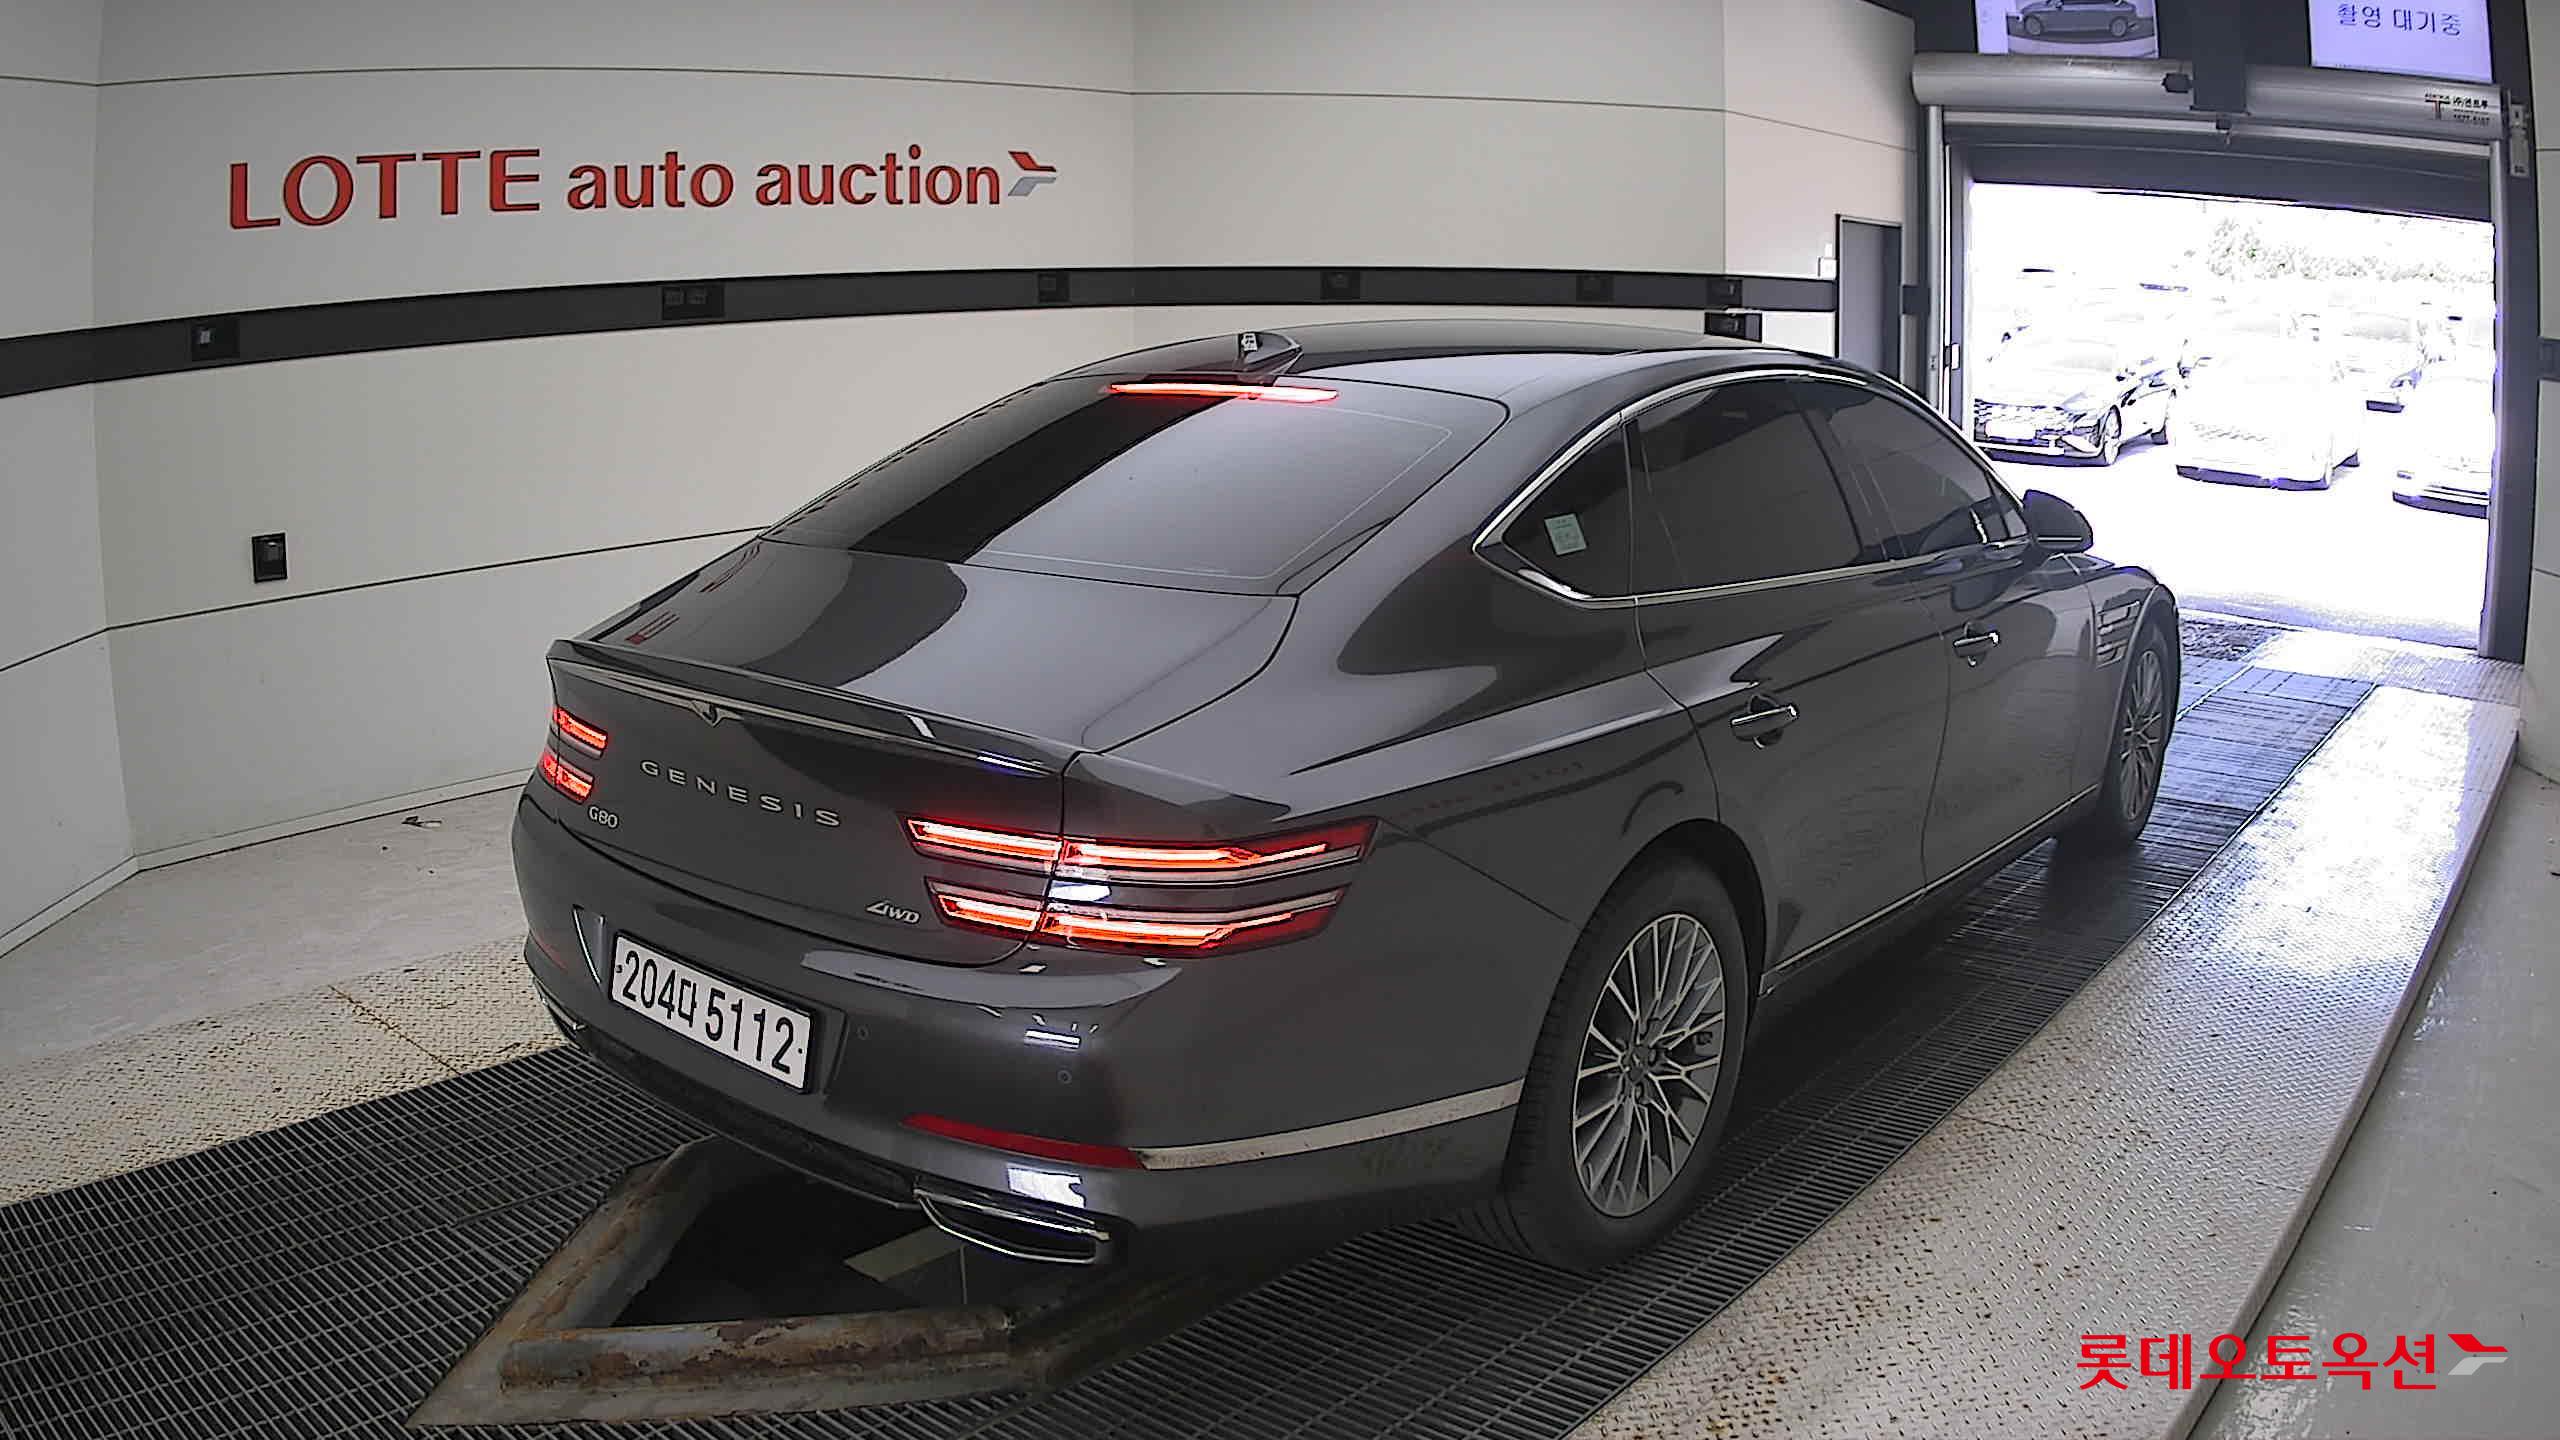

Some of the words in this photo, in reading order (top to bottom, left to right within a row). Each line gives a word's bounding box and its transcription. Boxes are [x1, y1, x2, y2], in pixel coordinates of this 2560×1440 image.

[2338, 4, 2381, 28] 촬영
[2393, 9, 2461, 36] 대기중
[229, 148, 540, 230] LOTTE
[566, 151, 735, 209] auto
[756, 144, 1001, 207] auction
[588, 806, 618, 829] G80
[641, 761, 840, 827] GENESIS
[622, 950, 698, 1028] 204다
[704, 987, 795, 1075] 5112
